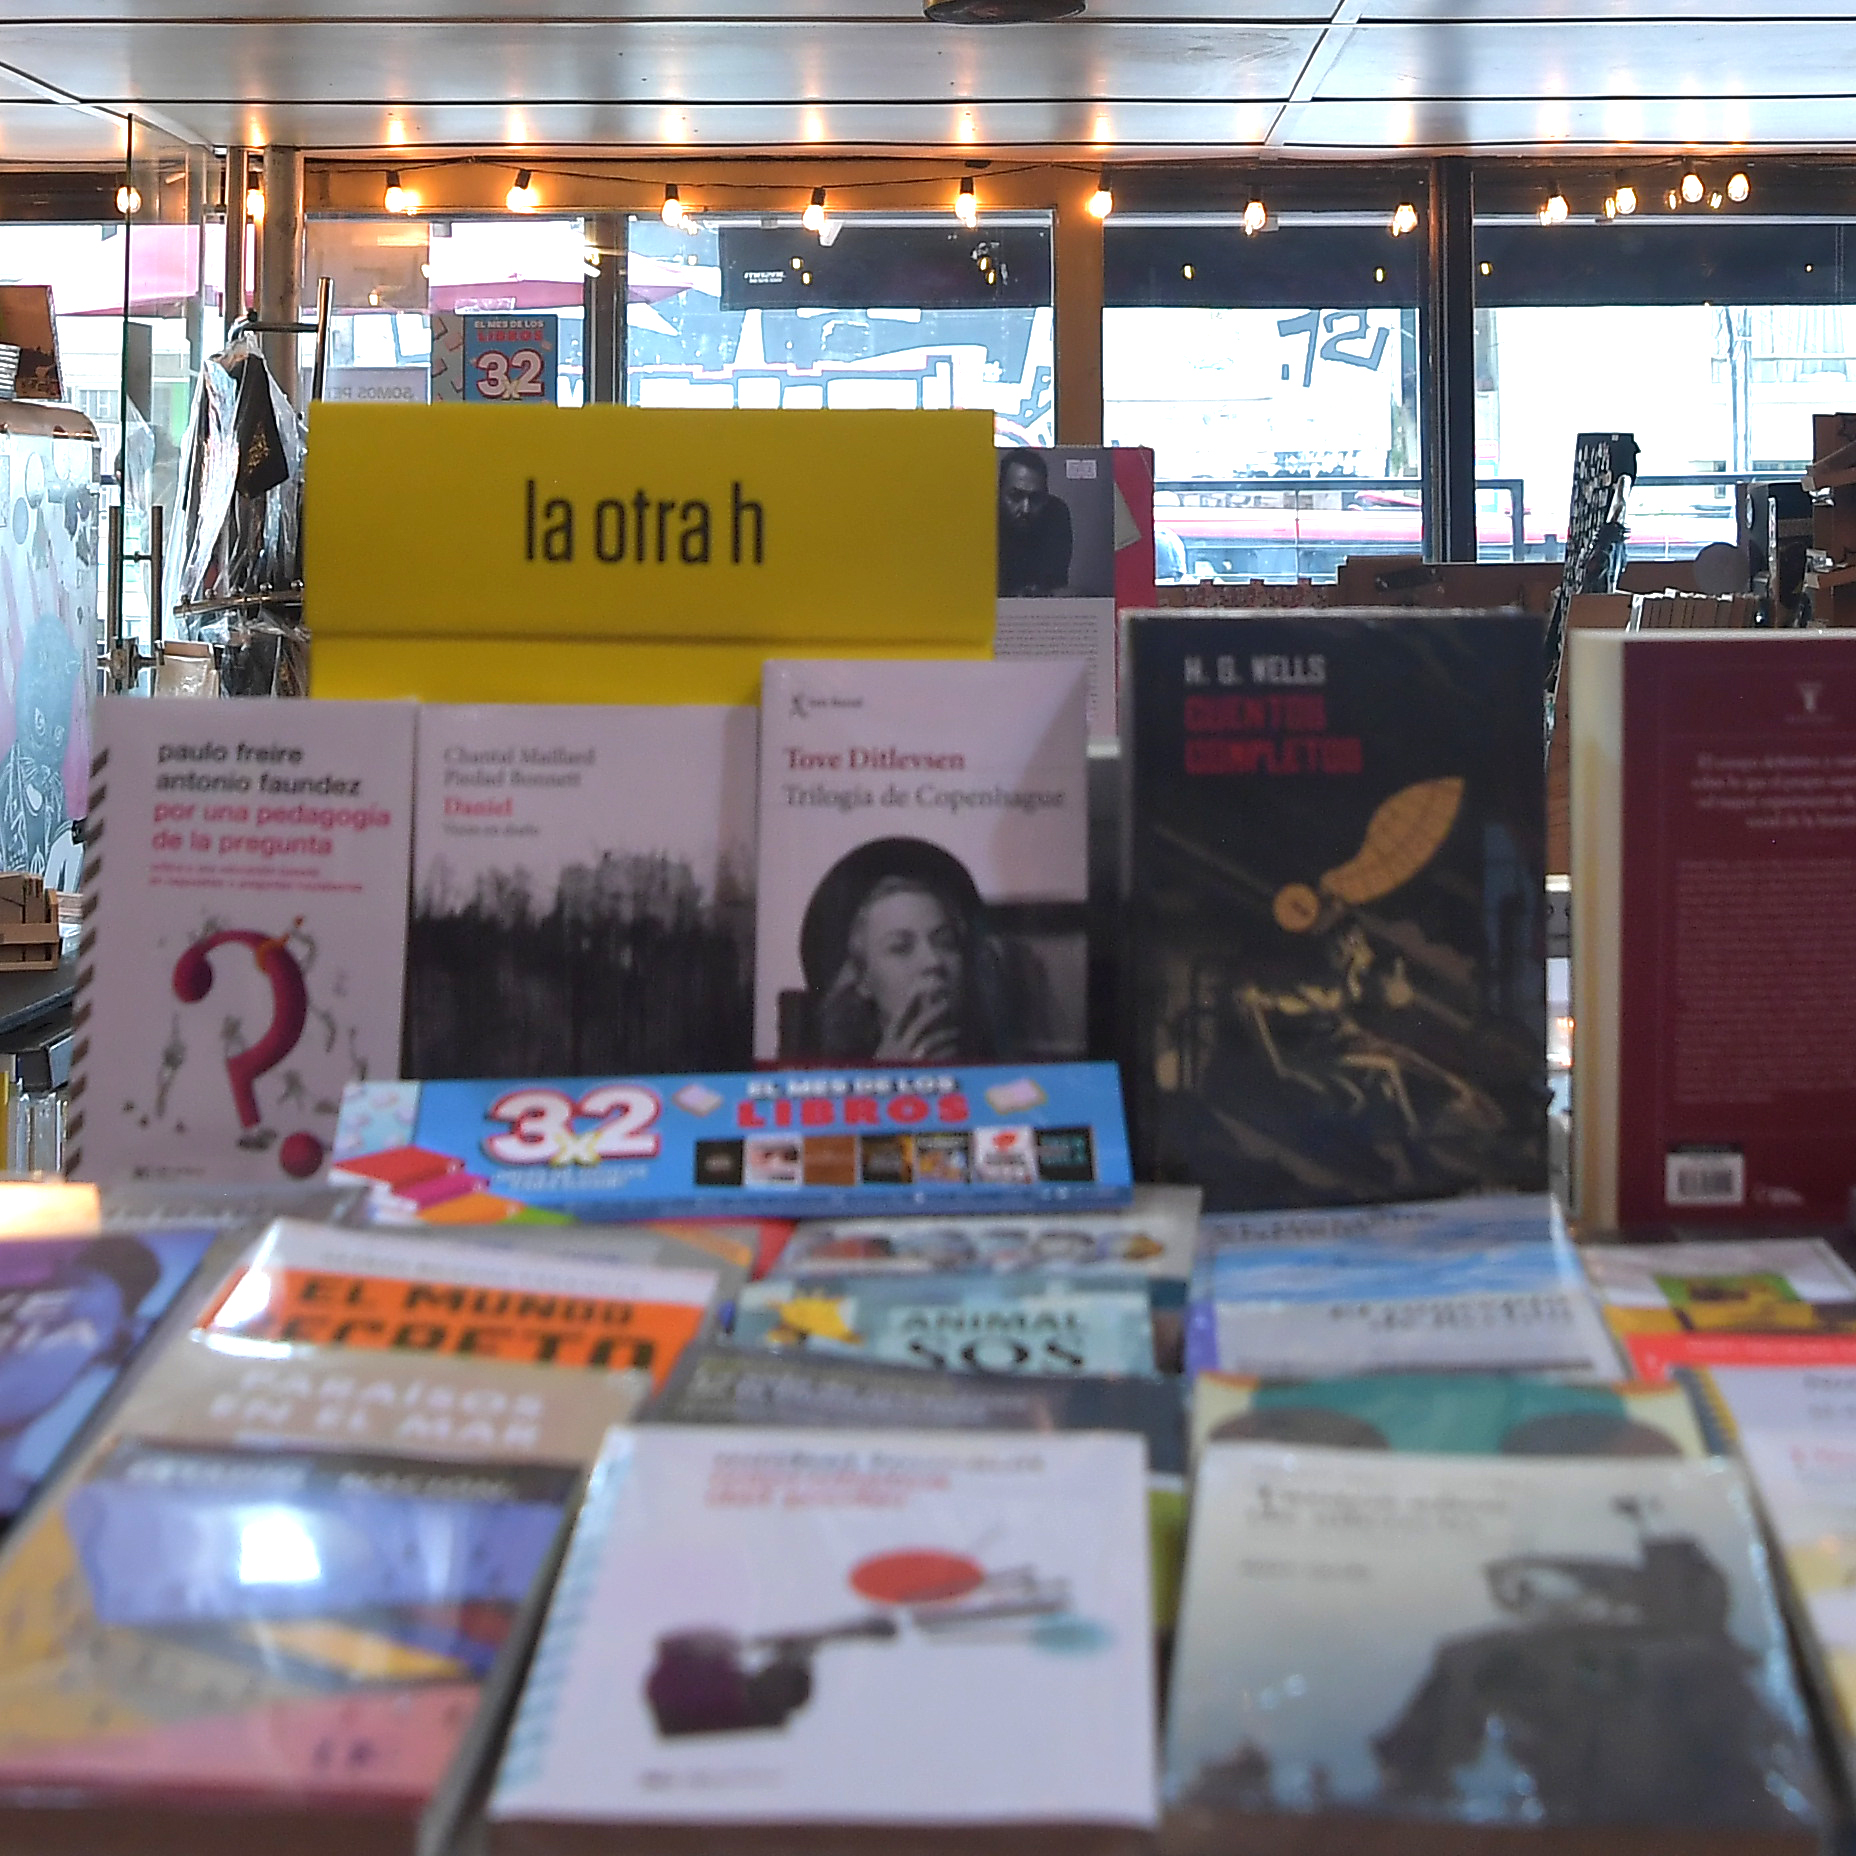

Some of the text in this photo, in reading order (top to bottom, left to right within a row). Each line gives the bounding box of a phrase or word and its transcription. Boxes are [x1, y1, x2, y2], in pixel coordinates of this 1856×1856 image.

[477, 330, 544, 342] LIBROS
[524, 480, 766, 567] la otra h
[1252, 655, 1327, 684] WELLS
[1185, 695, 1327, 732] CUENTOS
[157, 741, 304, 766] paulo freire
[442, 745, 597, 766] Chantal Maillard
[783, 747, 966, 773] Tove Ditlevsen
[1185, 738, 1364, 774] COMPLETOS
[155, 771, 363, 798] antonio faundez
[442, 768, 505, 788] Piedad
[442, 795, 514, 819] Daniel
[781, 781, 1067, 816] Trilogía de Copenhague
[153, 800, 392, 833] por una pedagogía
[152, 831, 334, 858] de la pregunta
[786, 1079, 845, 1097] MES
[899, 1075, 958, 1094] LOS
[738, 1095, 970, 1130] LIBROS
[299, 1277, 634, 1326] EL MUNDO
[902, 1310, 1082, 1334] ANIMAL
[241, 1368, 544, 1419] PARAÍSOS
[209, 1393, 541, 1448] EN EL MAR
